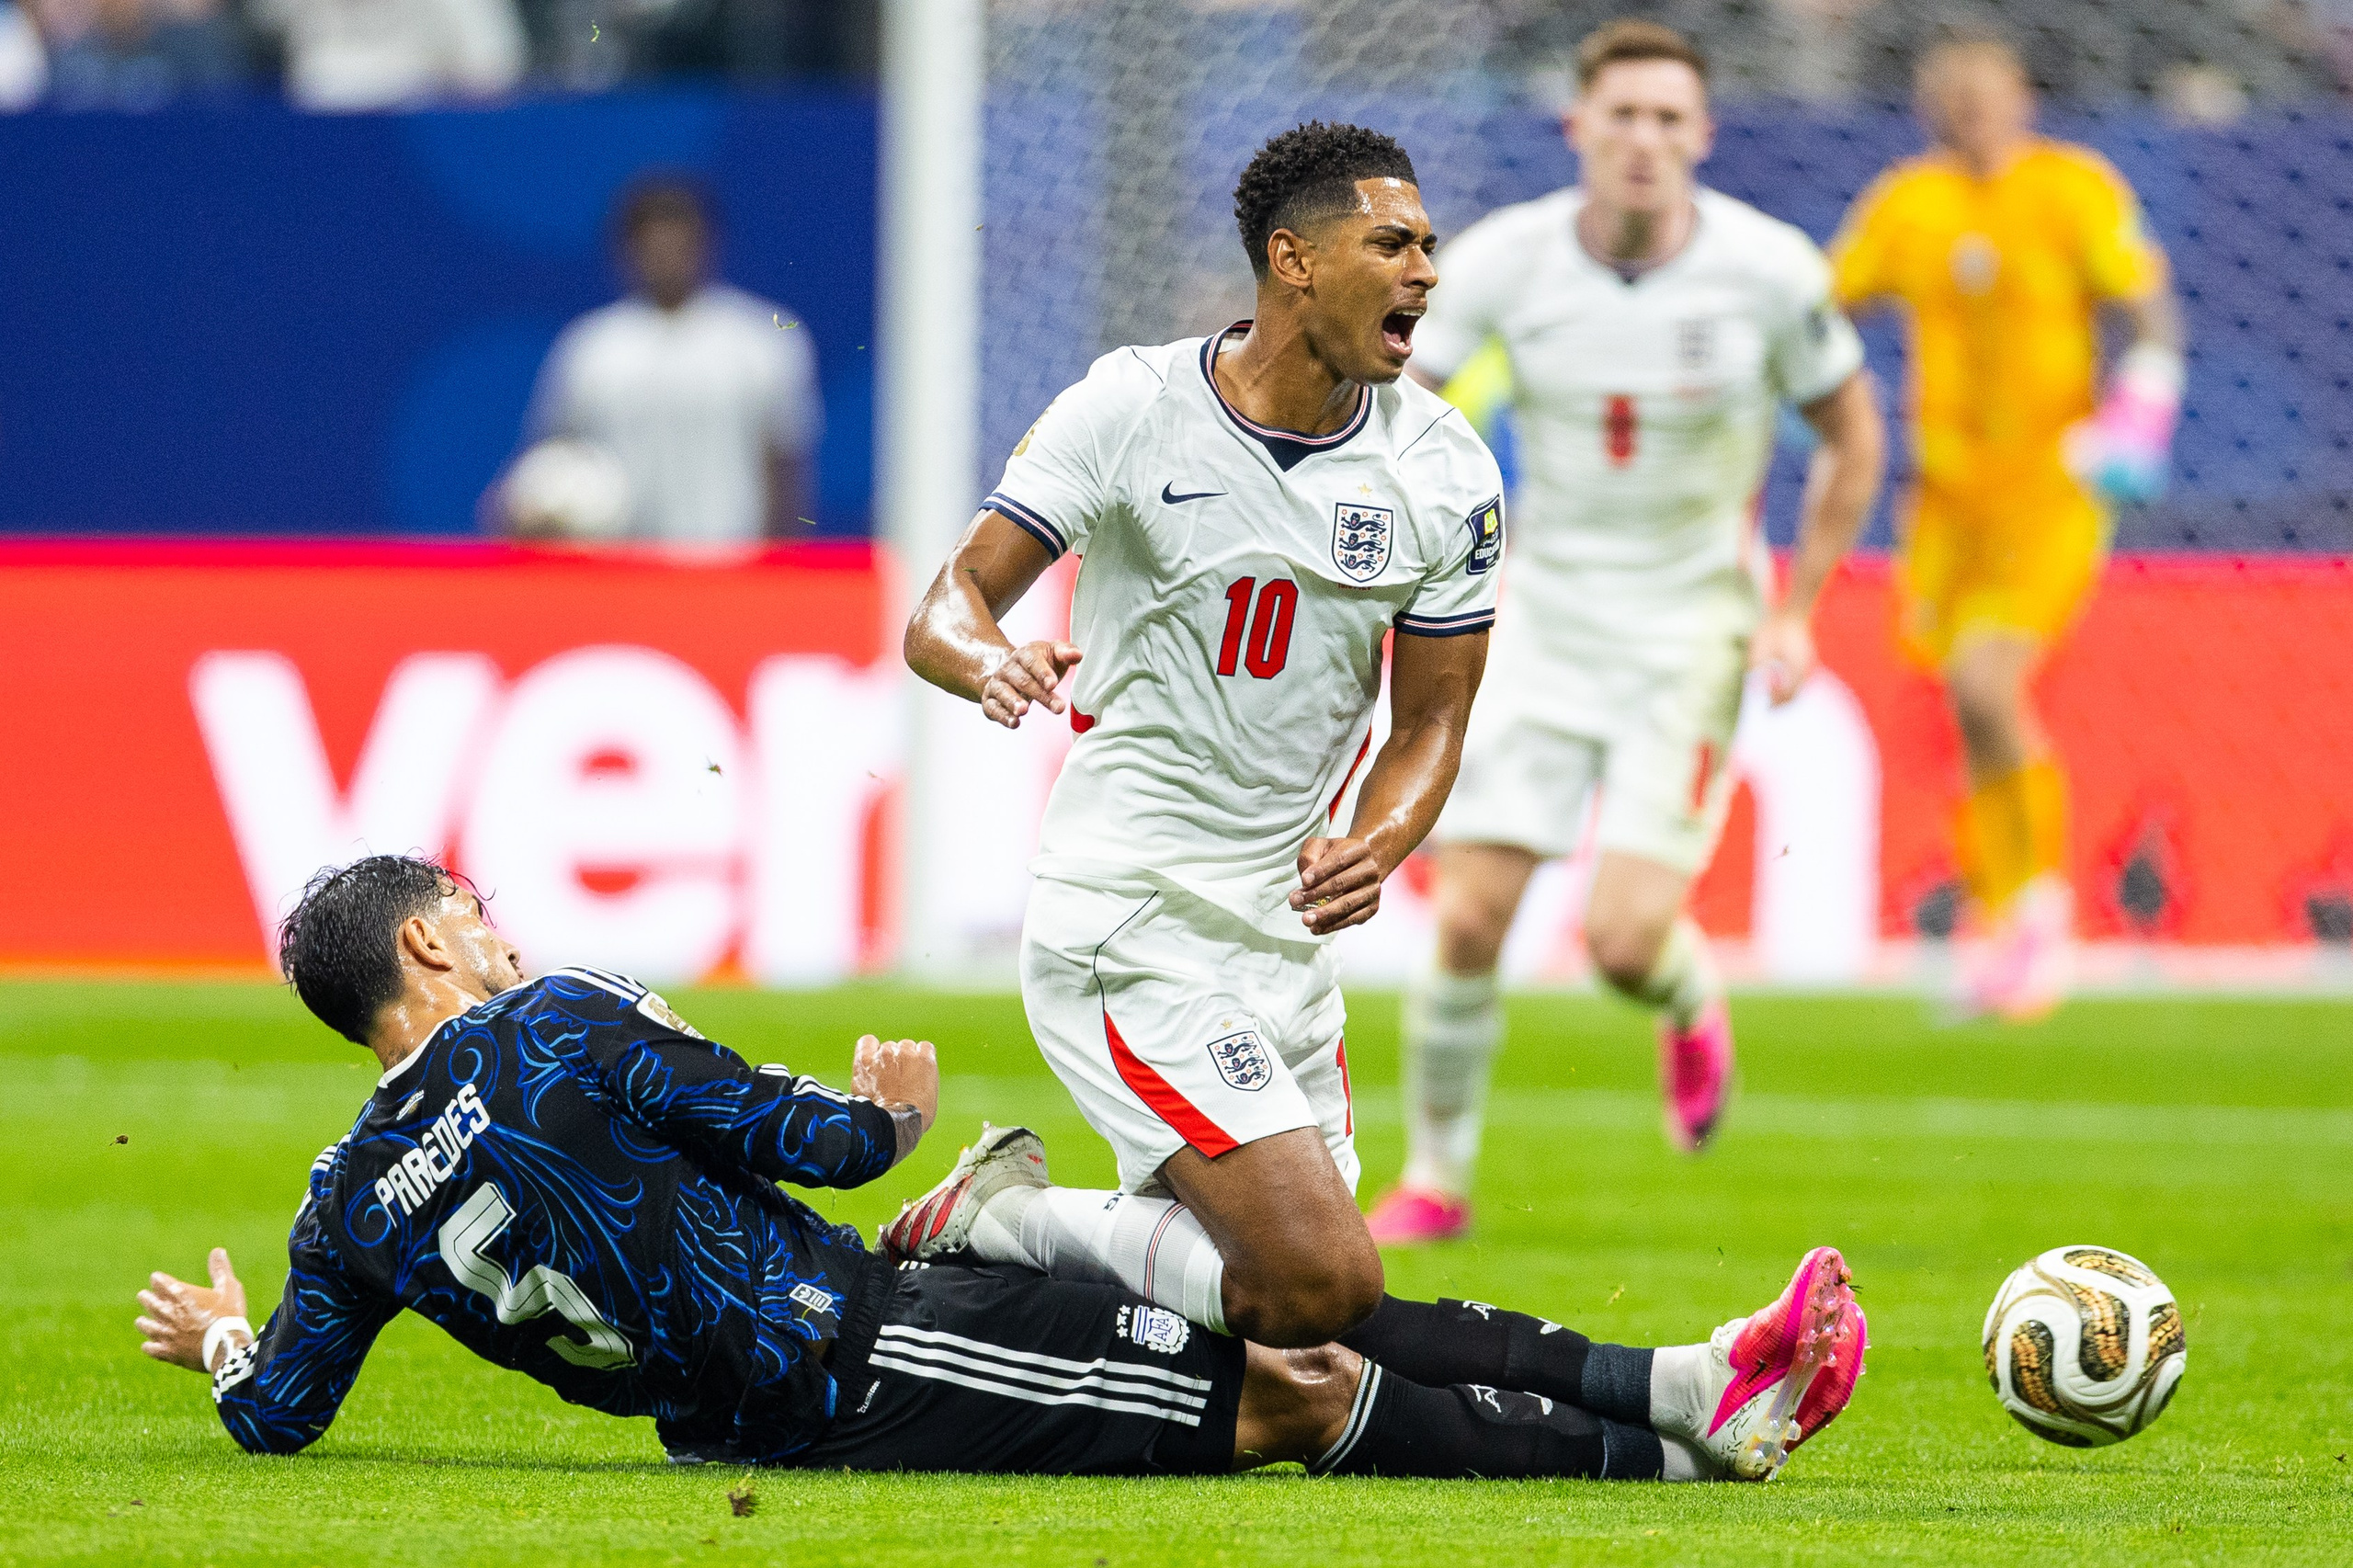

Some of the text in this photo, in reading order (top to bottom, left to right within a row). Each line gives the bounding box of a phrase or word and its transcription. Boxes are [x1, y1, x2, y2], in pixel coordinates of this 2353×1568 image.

[1216, 575, 1299, 680] 10
[374, 1083, 491, 1229] PAREDES
[438, 1181, 638, 1371] 5
